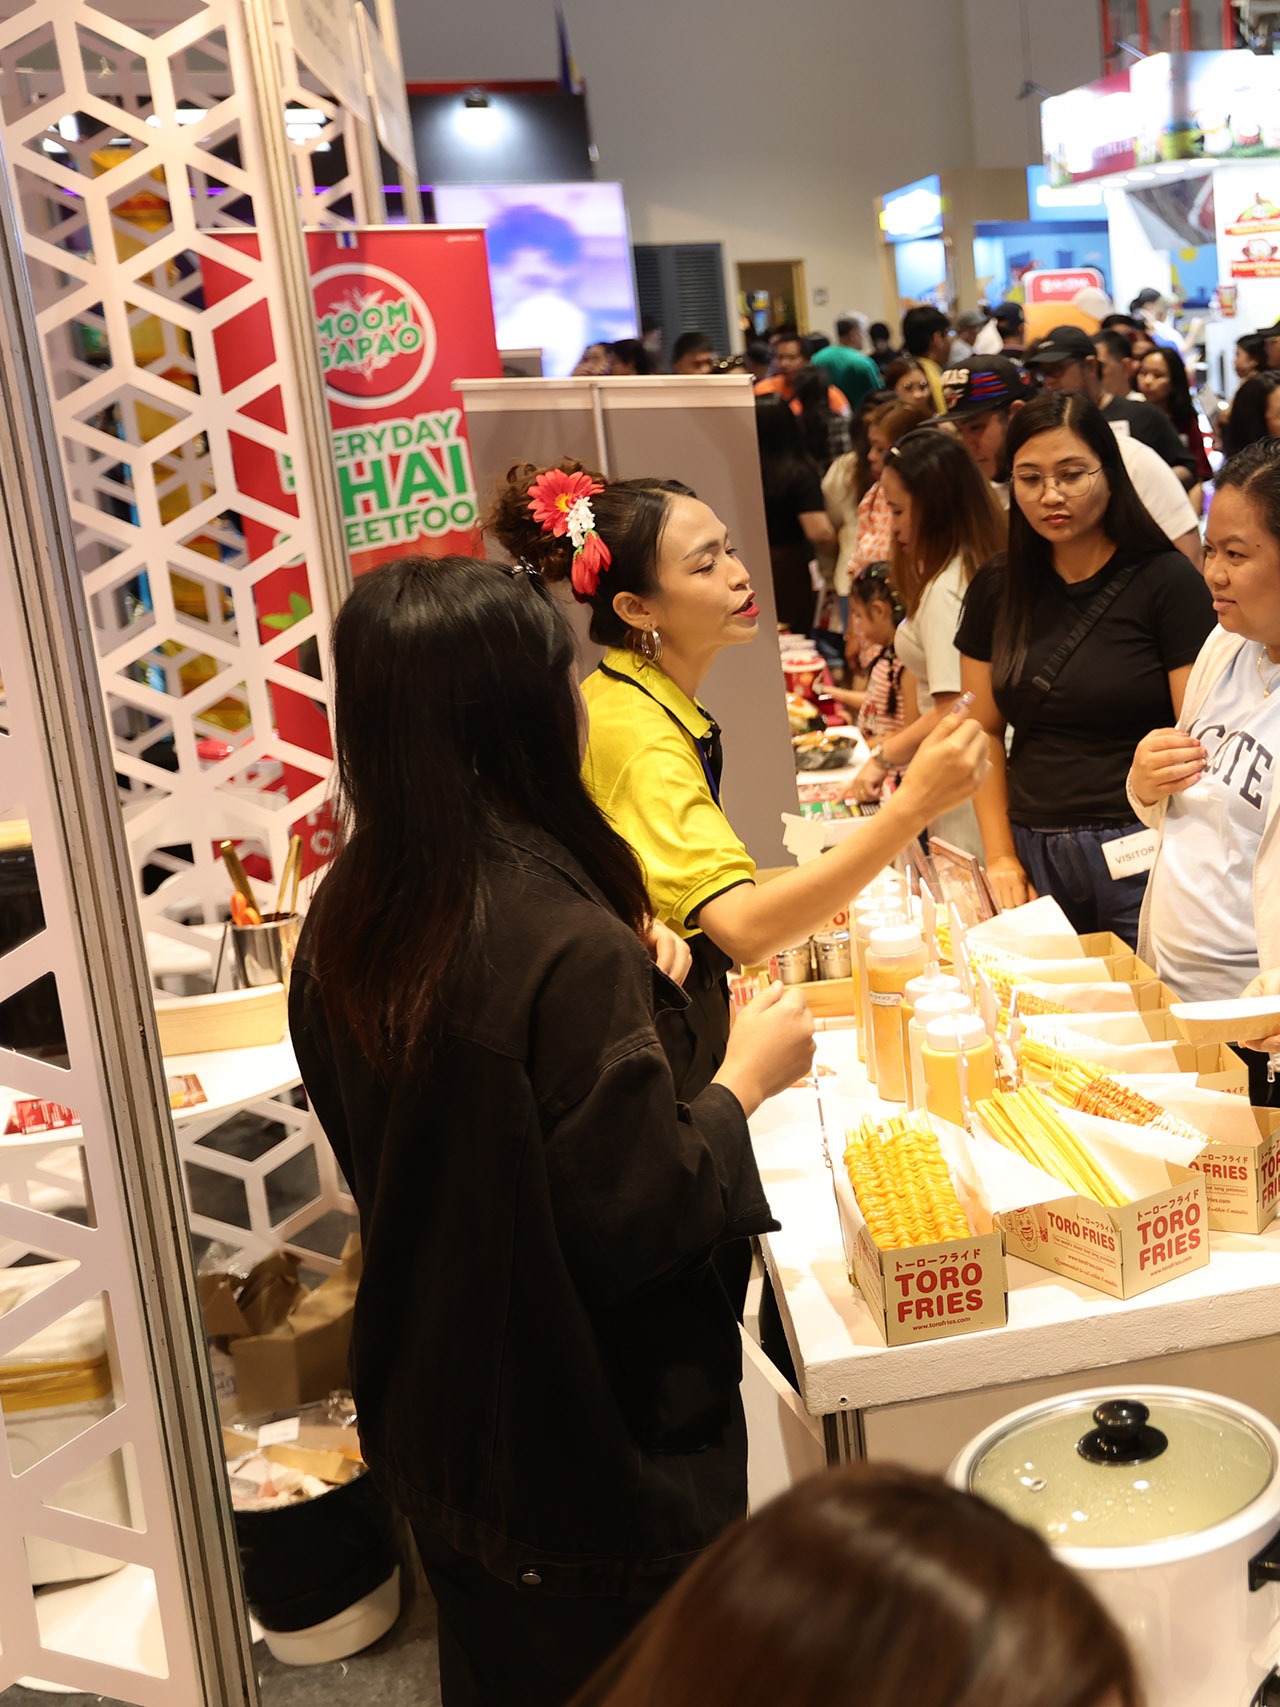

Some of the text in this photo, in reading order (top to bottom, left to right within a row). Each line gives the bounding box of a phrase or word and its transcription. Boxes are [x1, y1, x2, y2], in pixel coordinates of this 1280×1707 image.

[332, 415, 454, 461] ERYDAY
[337, 444, 467, 517] HAI
[345, 500, 475, 548] EETFOO
[1115, 844, 1156, 865] VISITOR
[1202, 1162, 1249, 1181] FRIES
[1047, 1210, 1116, 1252] TORO FRIES
[1136, 1202, 1201, 1245] TORO
[1138, 1227, 1201, 1271] FRIES
[894, 1262, 983, 1297] TORO
[897, 1289, 983, 1323] FRIES
[912, 1317, 971, 1331] www.torofries.com
